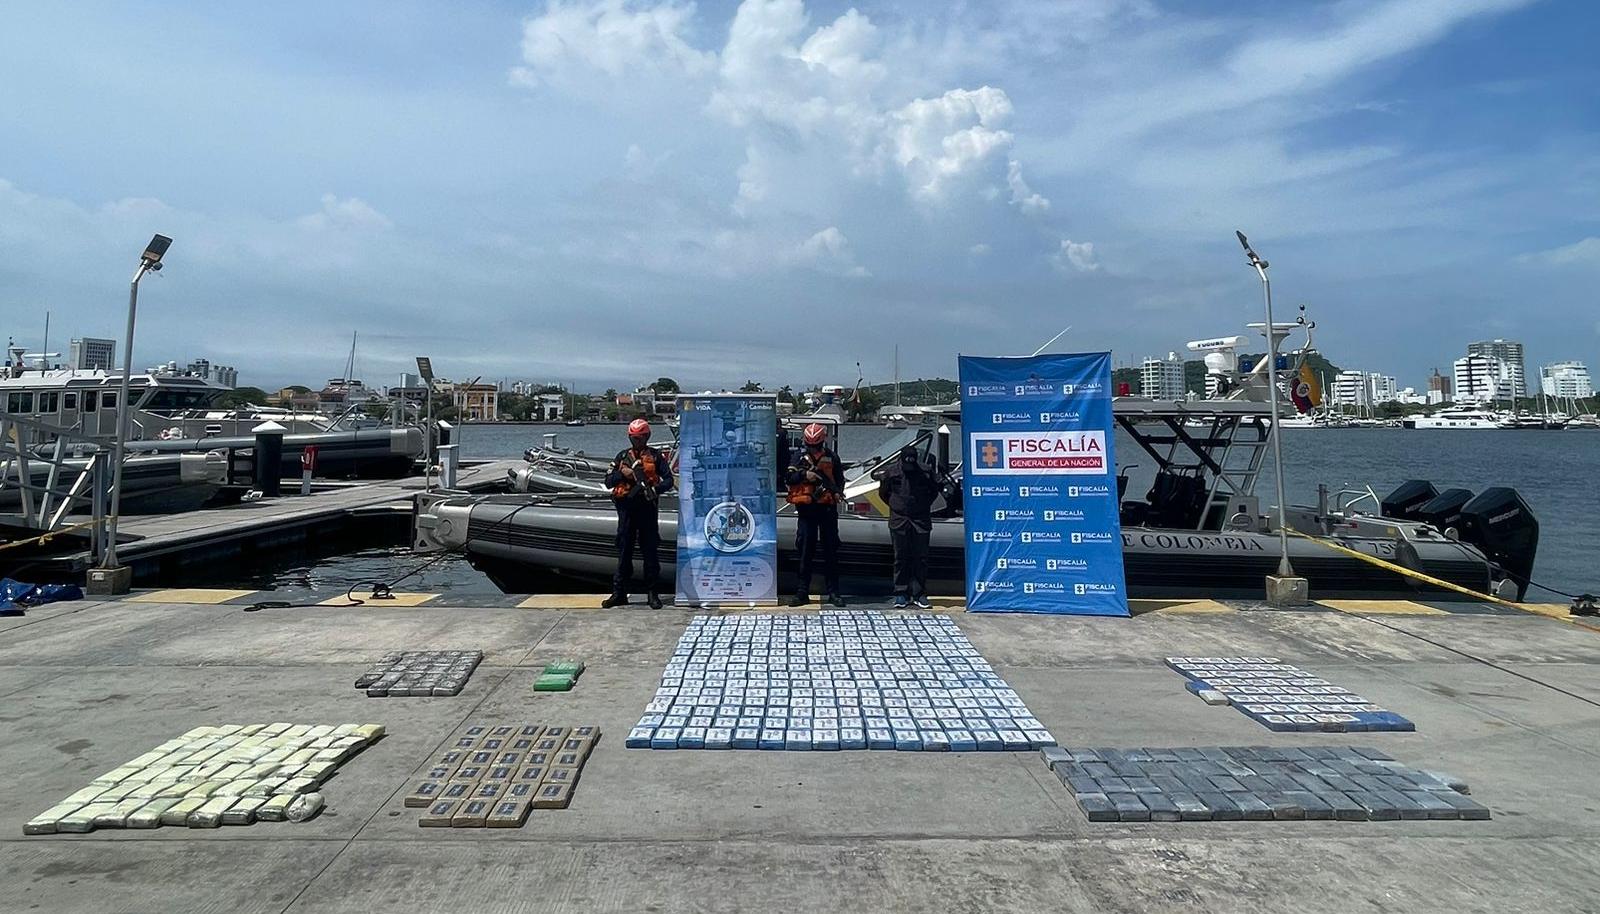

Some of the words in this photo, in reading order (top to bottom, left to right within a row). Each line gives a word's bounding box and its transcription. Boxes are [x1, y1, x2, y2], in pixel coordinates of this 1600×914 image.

[1008, 435, 1101, 453] FISCALÍA
[1011, 459, 1046, 467] GENERAL
[1047, 459, 1059, 467] DE
[1060, 458, 1070, 467] LA
[1071, 457, 1101, 467] NACIÓN
[1121, 533, 1135, 547] E
[1141, 534, 1264, 551] COLOMBIA
